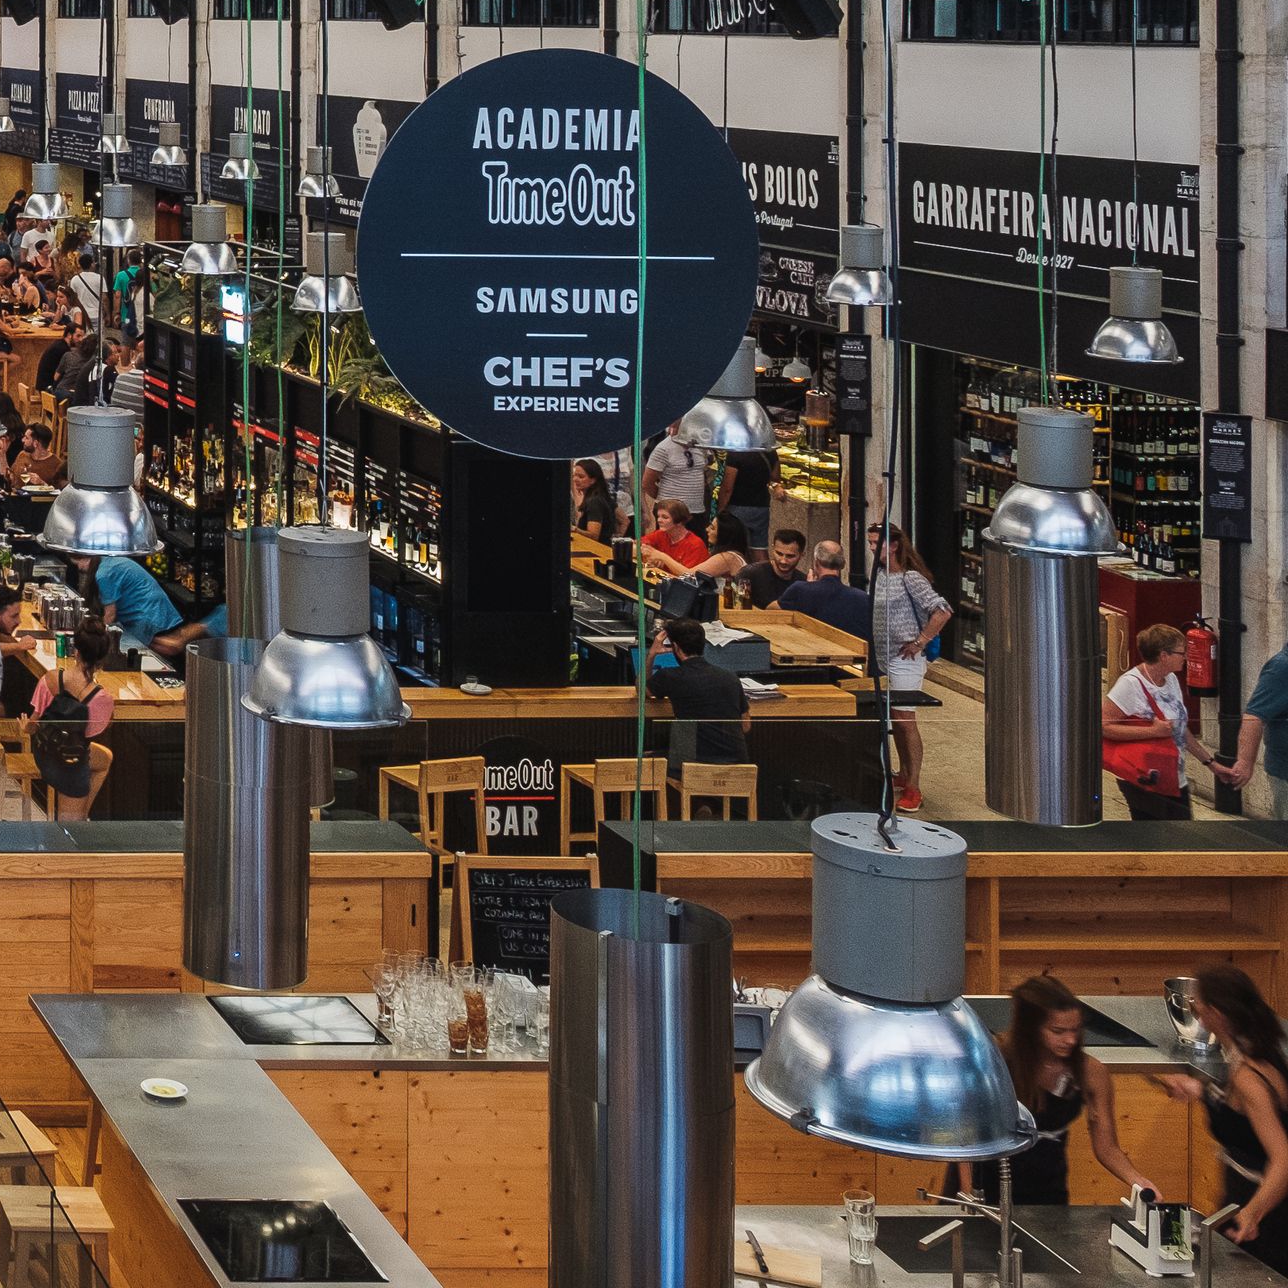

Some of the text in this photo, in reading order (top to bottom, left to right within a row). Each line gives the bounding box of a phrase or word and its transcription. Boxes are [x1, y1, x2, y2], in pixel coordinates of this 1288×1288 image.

[87, 92, 99, 113] PEZZ
[234, 106, 271, 136] HONRATO
[472, 107, 640, 151] ACADEMIA
[765, 164, 819, 209] BOLOS
[760, 210, 793, 231] Portugal
[913, 180, 1195, 258] GARRAFEIRA NACIONAL
[778, 257, 814, 274] CHEESE
[790, 271, 815, 286] CAKE
[476, 286, 639, 314] SAMSUNG
[483, 356, 630, 388] CHEF'S
[494, 396, 619, 412] EXPERIENCE
[485, 805, 538, 836] BAR
